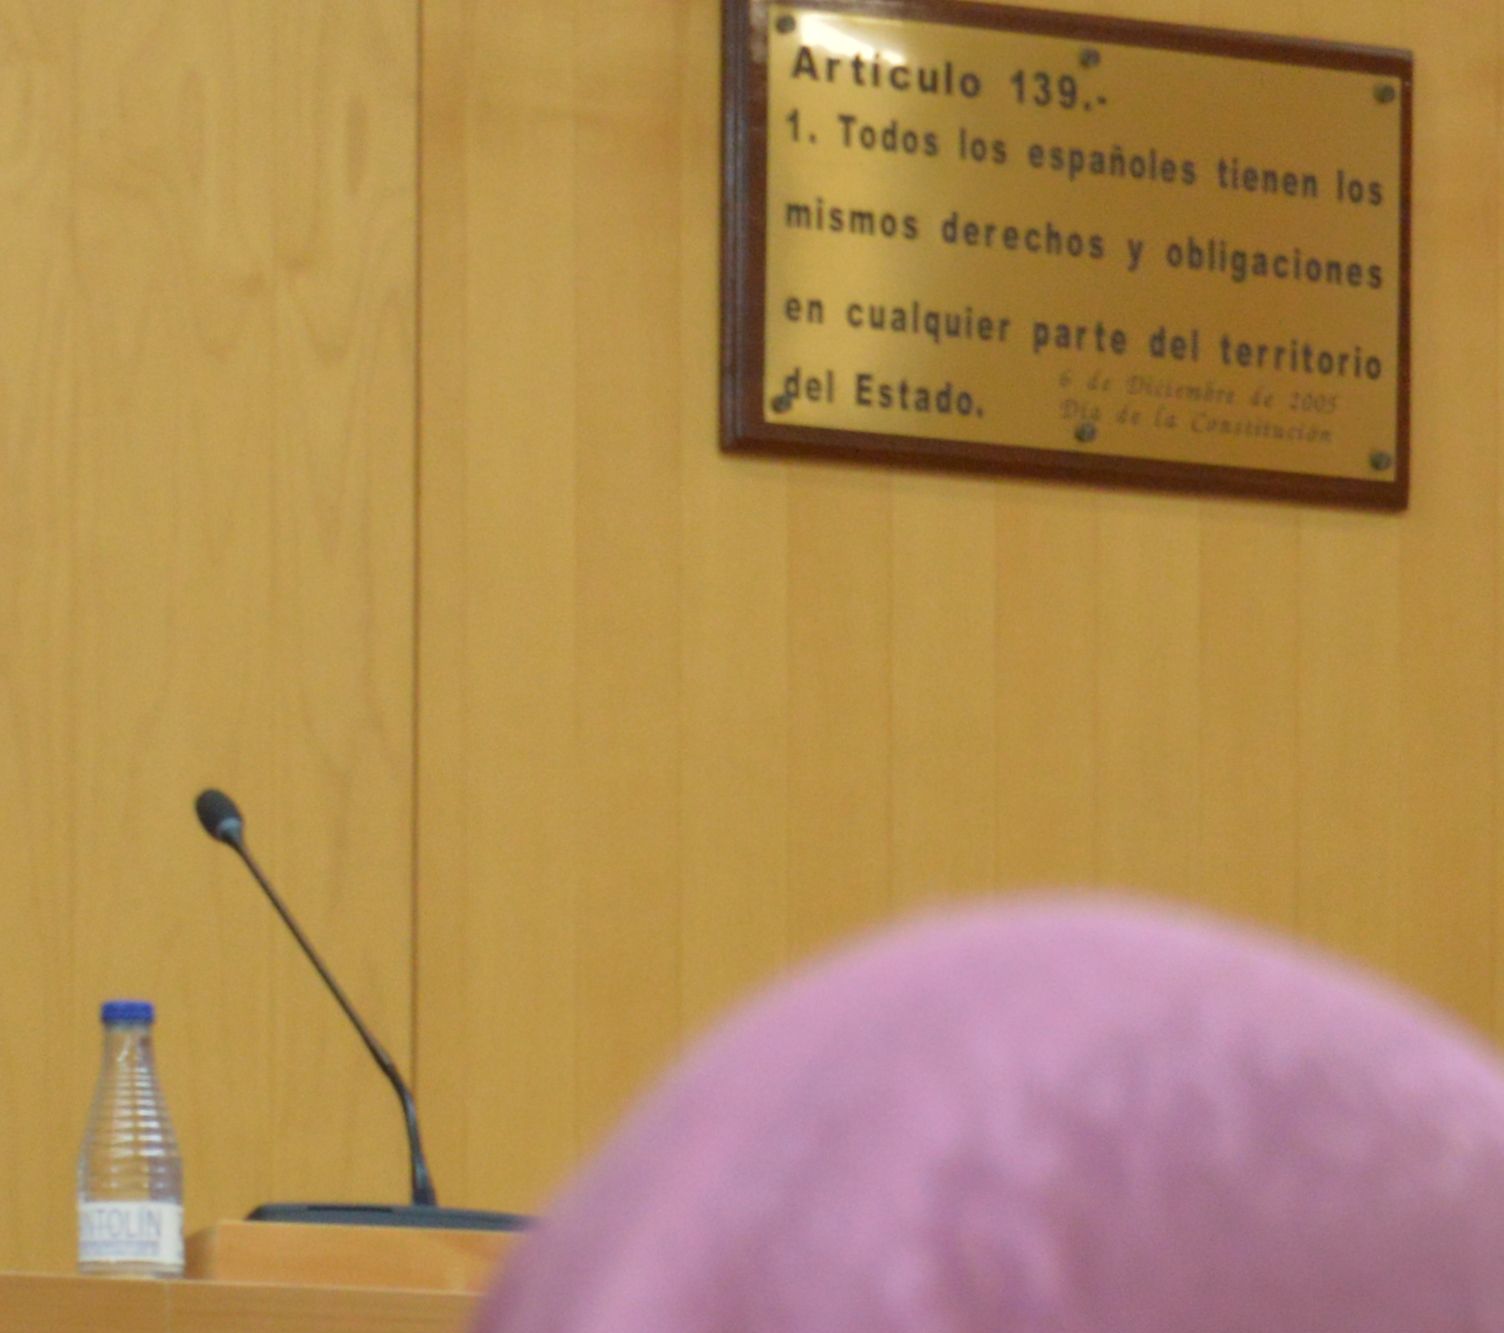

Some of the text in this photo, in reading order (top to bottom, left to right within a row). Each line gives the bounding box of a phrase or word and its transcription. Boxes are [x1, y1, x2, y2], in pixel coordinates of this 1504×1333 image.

[1011, 69, 1107, 111] 139.-
[786, 109, 1382, 205] 1. Todos los españoles tienen los
[785, 198, 1382, 289] mismos derechos y obligaciones
[784, 297, 1382, 380] en cualquier parte del territorio
[784, 367, 984, 418] del Estado.
[1087, 370, 1111, 391] de
[1251, 385, 1275, 408] de
[1117, 406, 1142, 426] de
[1154, 404, 1178, 428] la
